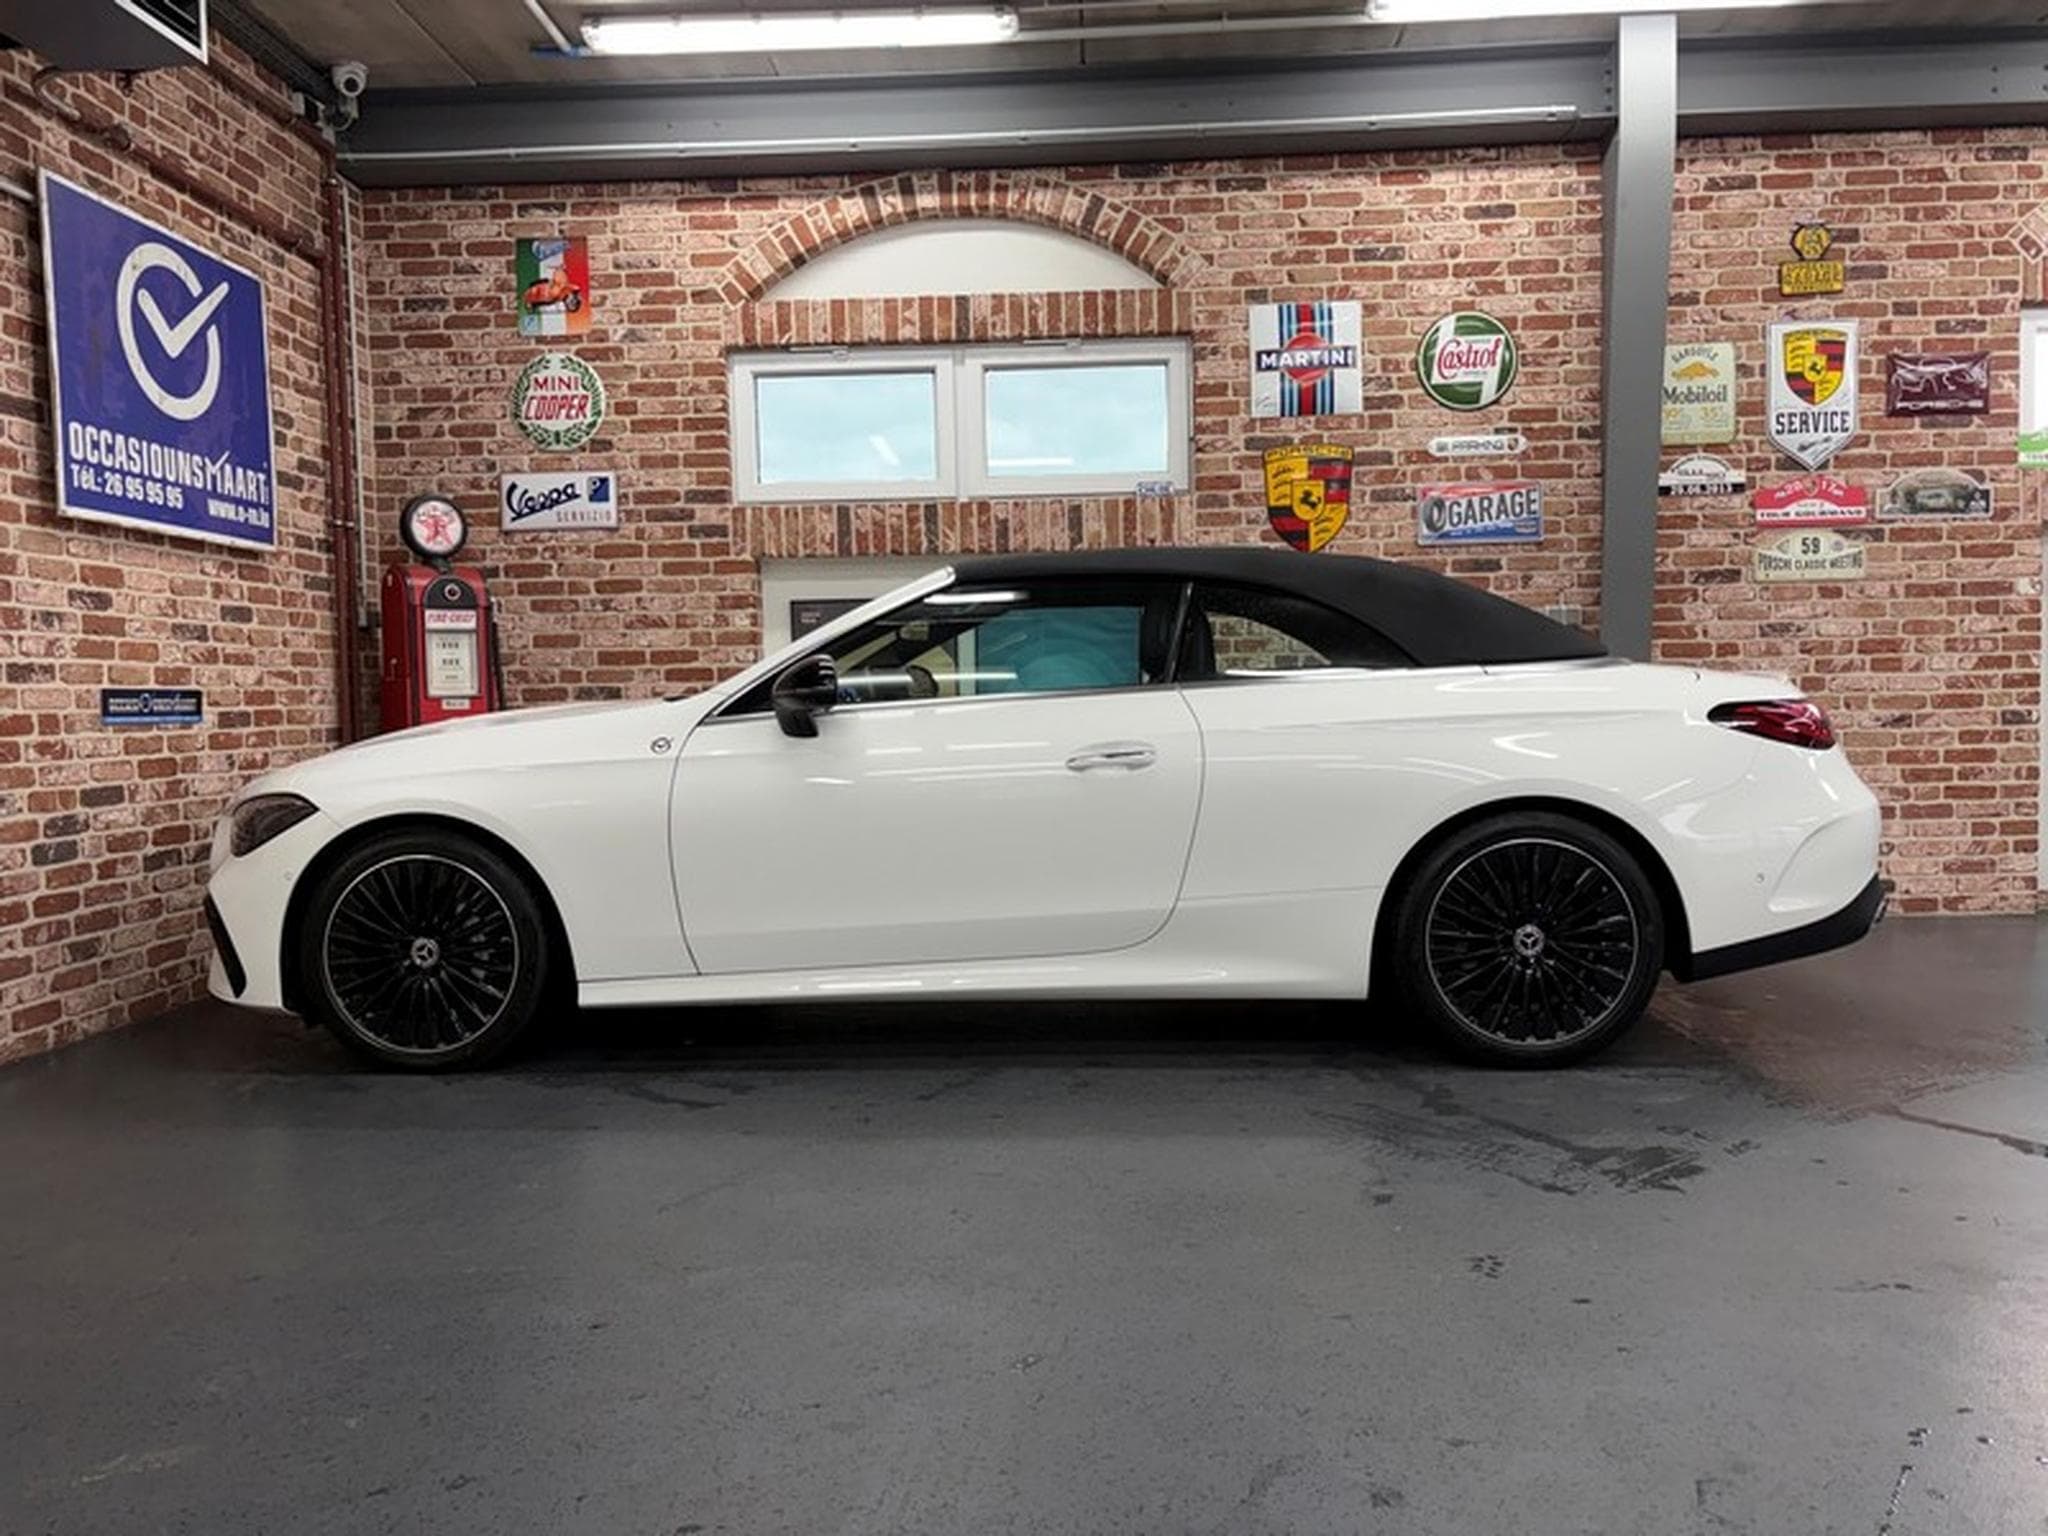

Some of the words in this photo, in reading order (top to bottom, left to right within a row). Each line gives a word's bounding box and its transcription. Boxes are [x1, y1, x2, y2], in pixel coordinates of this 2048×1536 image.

[1260, 349, 1352, 369] MARTINI
[1437, 336, 1502, 380] Castrol
[533, 375, 579, 392] MINI
[1662, 383, 1727, 405] Mobiloil
[523, 394, 589, 421] COOPER
[1775, 410, 1850, 436] SERVICE
[104, 471, 123, 497] 26
[125, 475, 144, 501] 95
[145, 480, 164, 506] 95
[166, 484, 184, 510] 95
[506, 481, 582, 522] Vespa
[1448, 487, 1538, 528] GARAGE
[1801, 537, 1821, 555] 59
